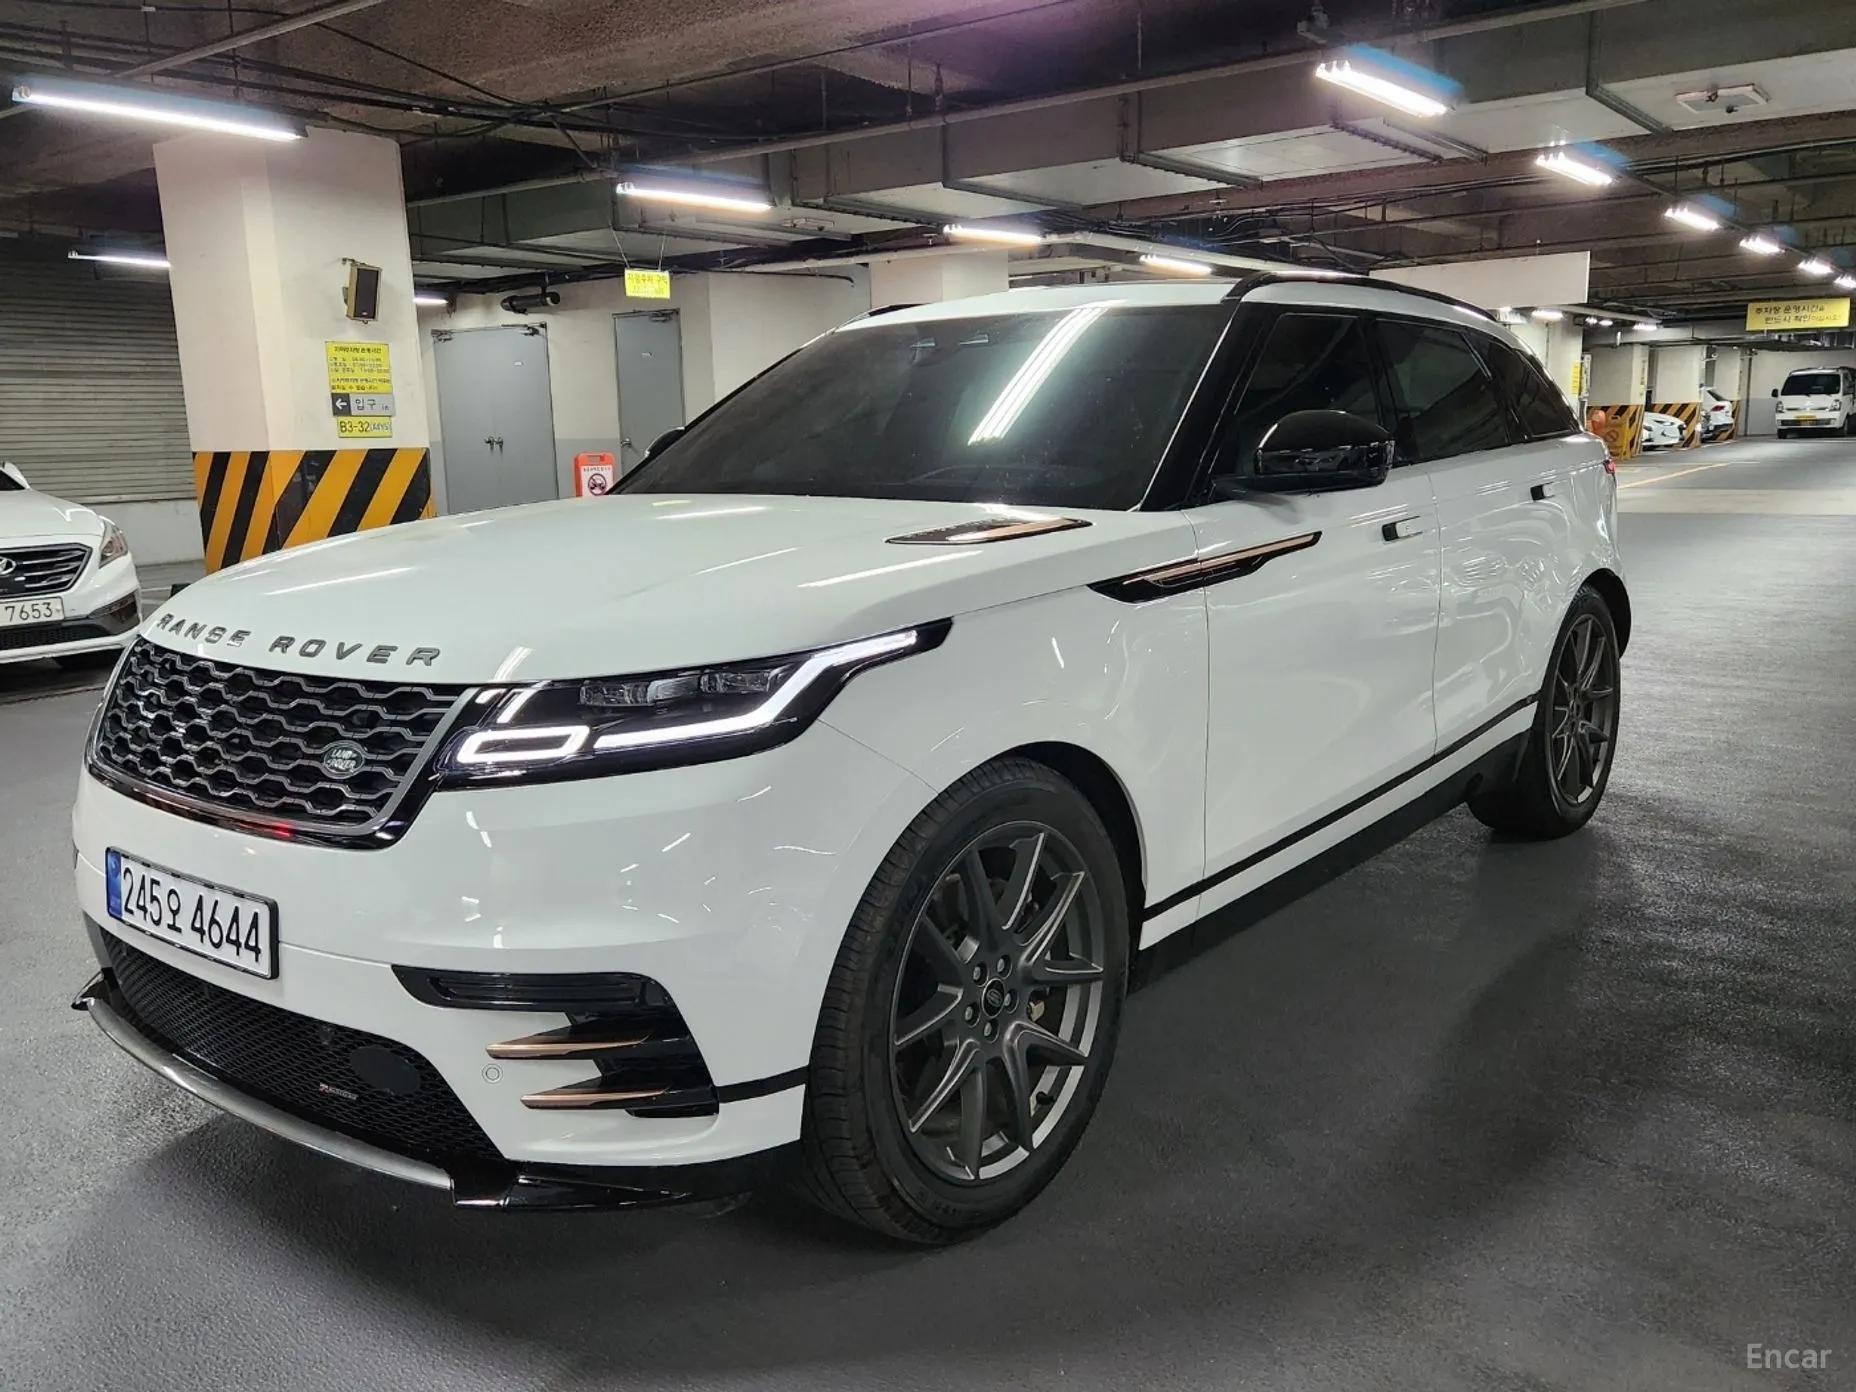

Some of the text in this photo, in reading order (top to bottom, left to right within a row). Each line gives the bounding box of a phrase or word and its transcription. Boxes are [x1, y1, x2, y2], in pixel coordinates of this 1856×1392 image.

[355, 396, 377, 411] 입구
[339, 420, 371, 434] B3-32
[4, 601, 53, 622] 7653
[156, 612, 441, 667] RANGE ROVER
[123, 867, 262, 963] 245오 4644
